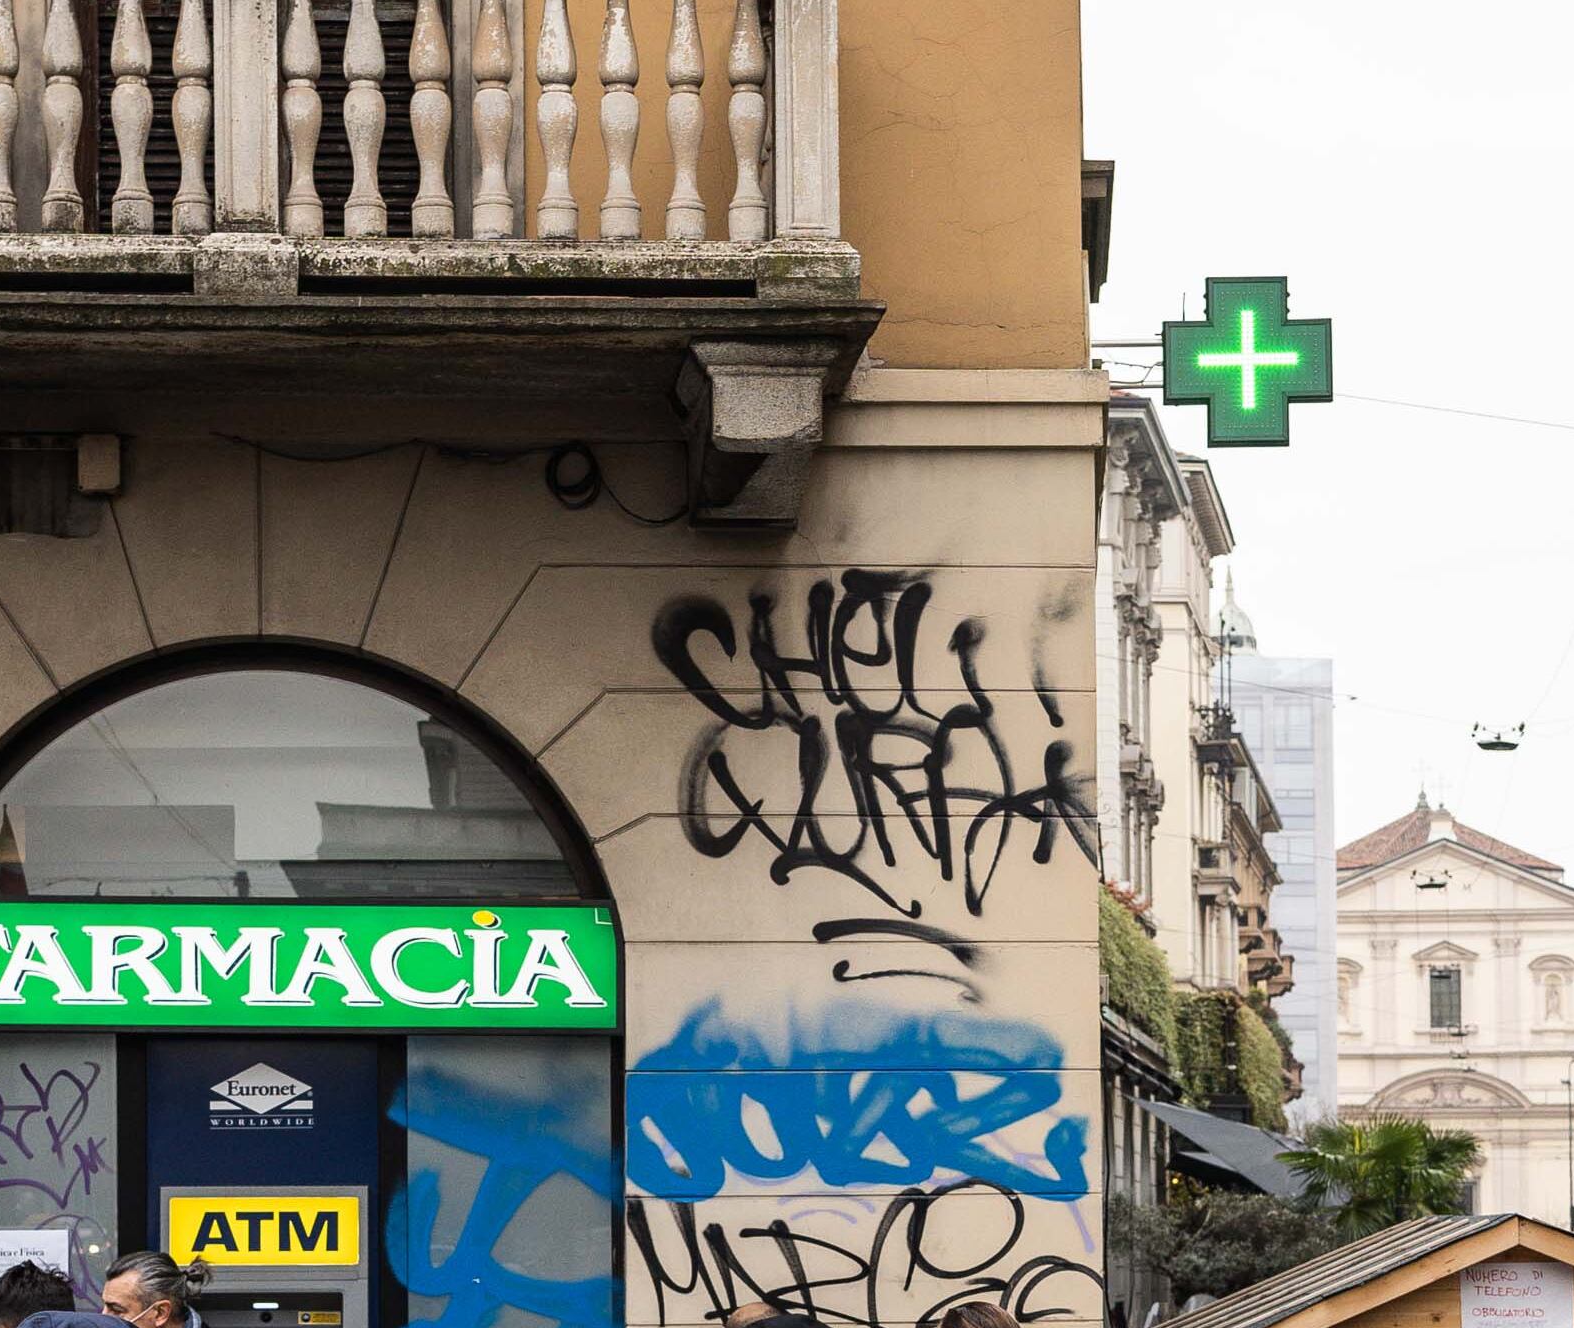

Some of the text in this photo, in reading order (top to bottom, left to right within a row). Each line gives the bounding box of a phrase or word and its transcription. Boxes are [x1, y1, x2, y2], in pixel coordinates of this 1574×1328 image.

[227, 1080, 297, 1097] Euronet
[209, 1117, 314, 1127] WORLDWIDE
[191, 1210, 340, 1253] ATM
[20, 1247, 45, 1257] Fisica
[1465, 1267, 1544, 1285] NUMERO DI
[1474, 1285, 1542, 1297] TELEFONO
